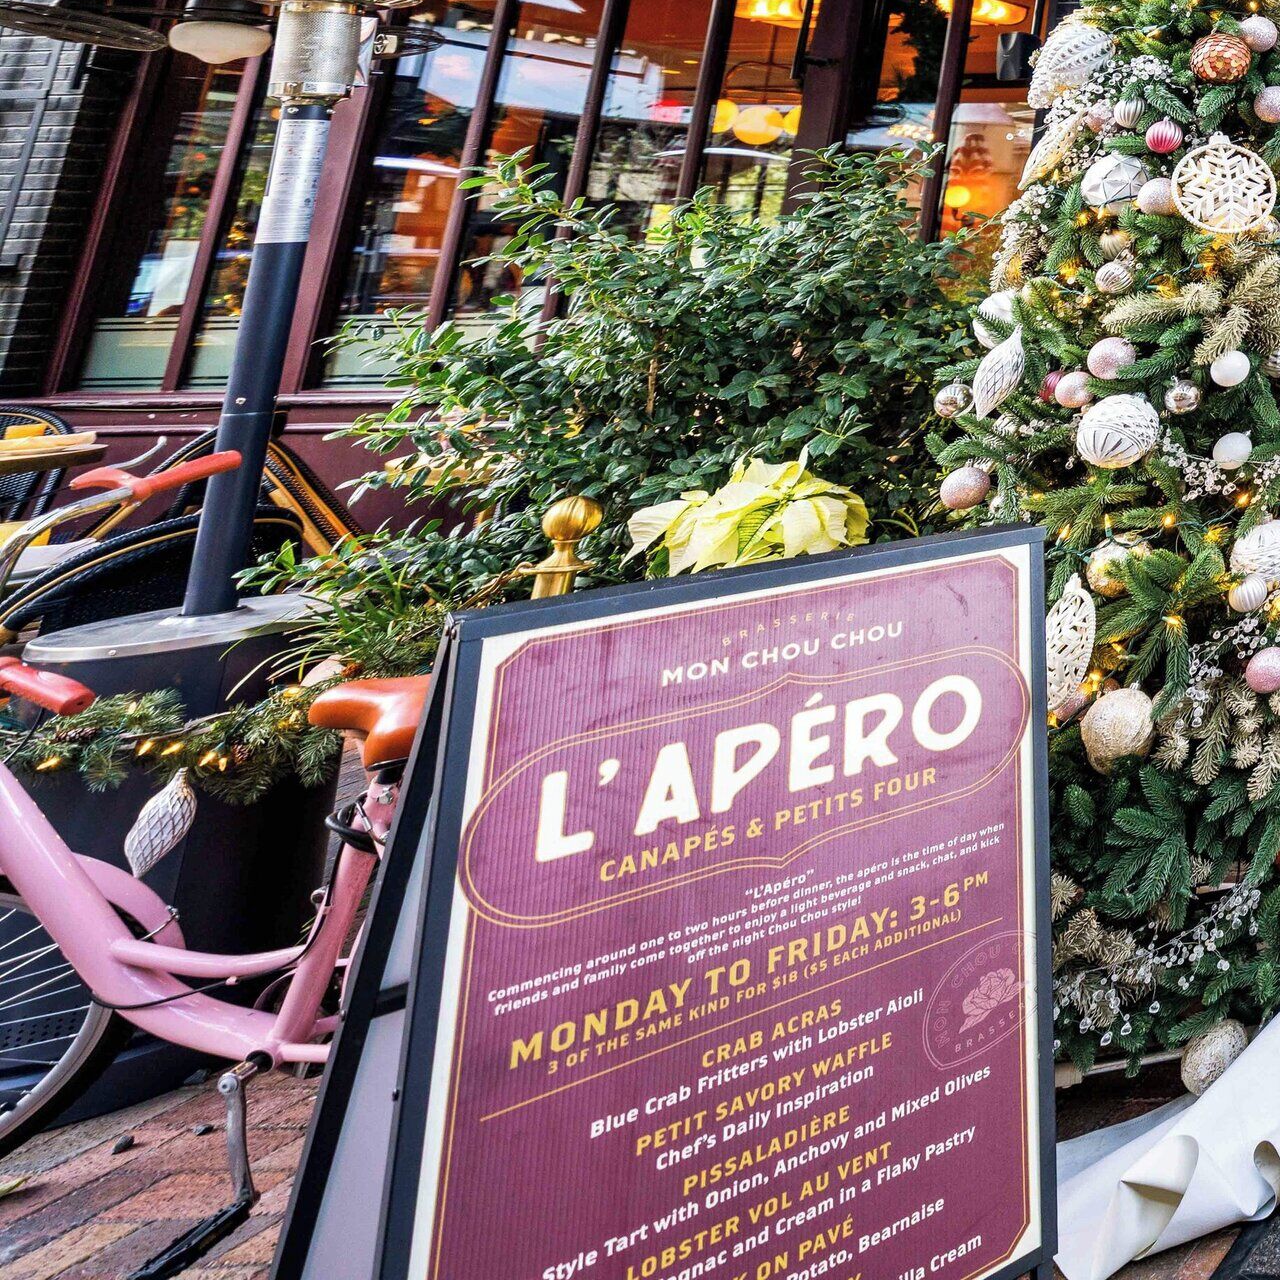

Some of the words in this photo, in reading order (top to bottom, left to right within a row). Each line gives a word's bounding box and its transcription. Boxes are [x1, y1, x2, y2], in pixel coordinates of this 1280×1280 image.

[662, 656, 729, 687] MON
[741, 638, 820, 669] CHOU
[830, 621, 902, 649] CHOU
[722, 611, 857, 647] BRASSERIE
[536, 674, 982, 863] L'APÉRO
[600, 824, 735, 882] CANAPÉS
[746, 817, 764, 838] &
[775, 788, 863, 831] PETITS
[874, 767, 936, 801] FOUR
[487, 963, 582, 1003] Commencing
[585, 943, 636, 970] around
[639, 936, 665, 952] one
[667, 930, 682, 942] to
[684, 921, 709, 936] two
[712, 908, 748, 927] hours
[750, 894, 790, 914] before
[792, 880, 833, 900] dinner,
[835, 872, 854, 885] the
[856, 861, 888, 878] apéro
[891, 857, 900, 867] is
[902, 851, 920, 863] the
[922, 842, 945, 856] time
[947, 836, 959, 848] of
[959, 831, 978, 843] day
[979, 823, 1005, 837] when
[494, 990, 549, 1016] friends
[552, 977, 580, 996] and
[583, 962, 627, 986] family
[630, 950, 666, 970] come
[669, 929, 726, 956] together
[728, 924, 741, 935] to
[744, 912, 778, 930] enjoy
[780, 908, 787, 918] a
[790, 897, 818, 914] light
[821, 880, 872, 904] beverage
[874, 870, 894, 886] and
[897, 860, 930, 878] snack,
[932, 851, 957, 865] chat,
[959, 842, 978, 856] and
[980, 835, 1000, 849] kick
[687, 948, 707, 964] off
[708, 942, 729, 957] the
[732, 929, 765, 949] night
[768, 919, 797, 936] Chou
[800, 908, 828, 924] Chou
[831, 895, 861, 914] style!
[745, 868, 814, 899] "L'Apéro"
[509, 977, 693, 1070] MONDAY
[704, 958, 751, 996] TO
[767, 907, 898, 974] FRIDAY:
[547, 1060, 559, 1075] 3
[566, 1048, 590, 1068] OF
[595, 1033, 630, 1056] THE
[635, 1013, 683, 1041] SAME
[689, 996, 730, 1021] KIND
[736, 982, 767, 1003] FOR
[772, 970, 798, 990] $18
[803, 959, 828, 979] ($5
[833, 943, 869, 967] EACH
[874, 908, 961, 952] ADDITIONAL)
[702, 1030, 763, 1068] CRAB
[771, 998, 842, 1041] ACRAS
[590, 1107, 639, 1139] Blue
[644, 1085, 692, 1115] Crab
[697, 1054, 768, 1095] Fritters
[772, 1035, 812, 1062] with
[818, 1007, 884, 1044] Lobster
[886, 987, 923, 1016] Aioli
[636, 1110, 707, 1157] PETIT
[715, 1067, 806, 1122] SAVORY
[812, 1031, 892, 1079] WAFFLE
[656, 1133, 717, 1171] Chef's
[722, 1109, 771, 1142] Daily
[776, 1065, 874, 1119] Inspiration
[603, 1223, 649, 1257] Tart
[653, 1201, 699, 1234] with
[705, 1172, 769, 1210] Onion,
[773, 1131, 850, 1178] Anchovy
[853, 1111, 886, 1140] and
[891, 1086, 940, 1122] Mixed
[944, 1065, 991, 1096] Olives
[683, 1104, 850, 1197] PISSALADIÈRE
[732, 1225, 770, 1258] and
[775, 1197, 834, 1236] Cream
[839, 1186, 856, 1205] in
[861, 1178, 872, 1193] a
[876, 1153, 921, 1186] Flaky
[925, 1125, 976, 1162] Pastry
[626, 1215, 740, 1280] LOBSTER
[748, 1191, 792, 1224] VOL
[799, 1171, 829, 1201] AU
[837, 1141, 892, 1181] VENT
[756, 1251, 788, 1280] ON
[798, 1213, 854, 1262] PAVÉ
[858, 1198, 945, 1254] Bearnaise
[930, 1234, 982, 1273] Cream
